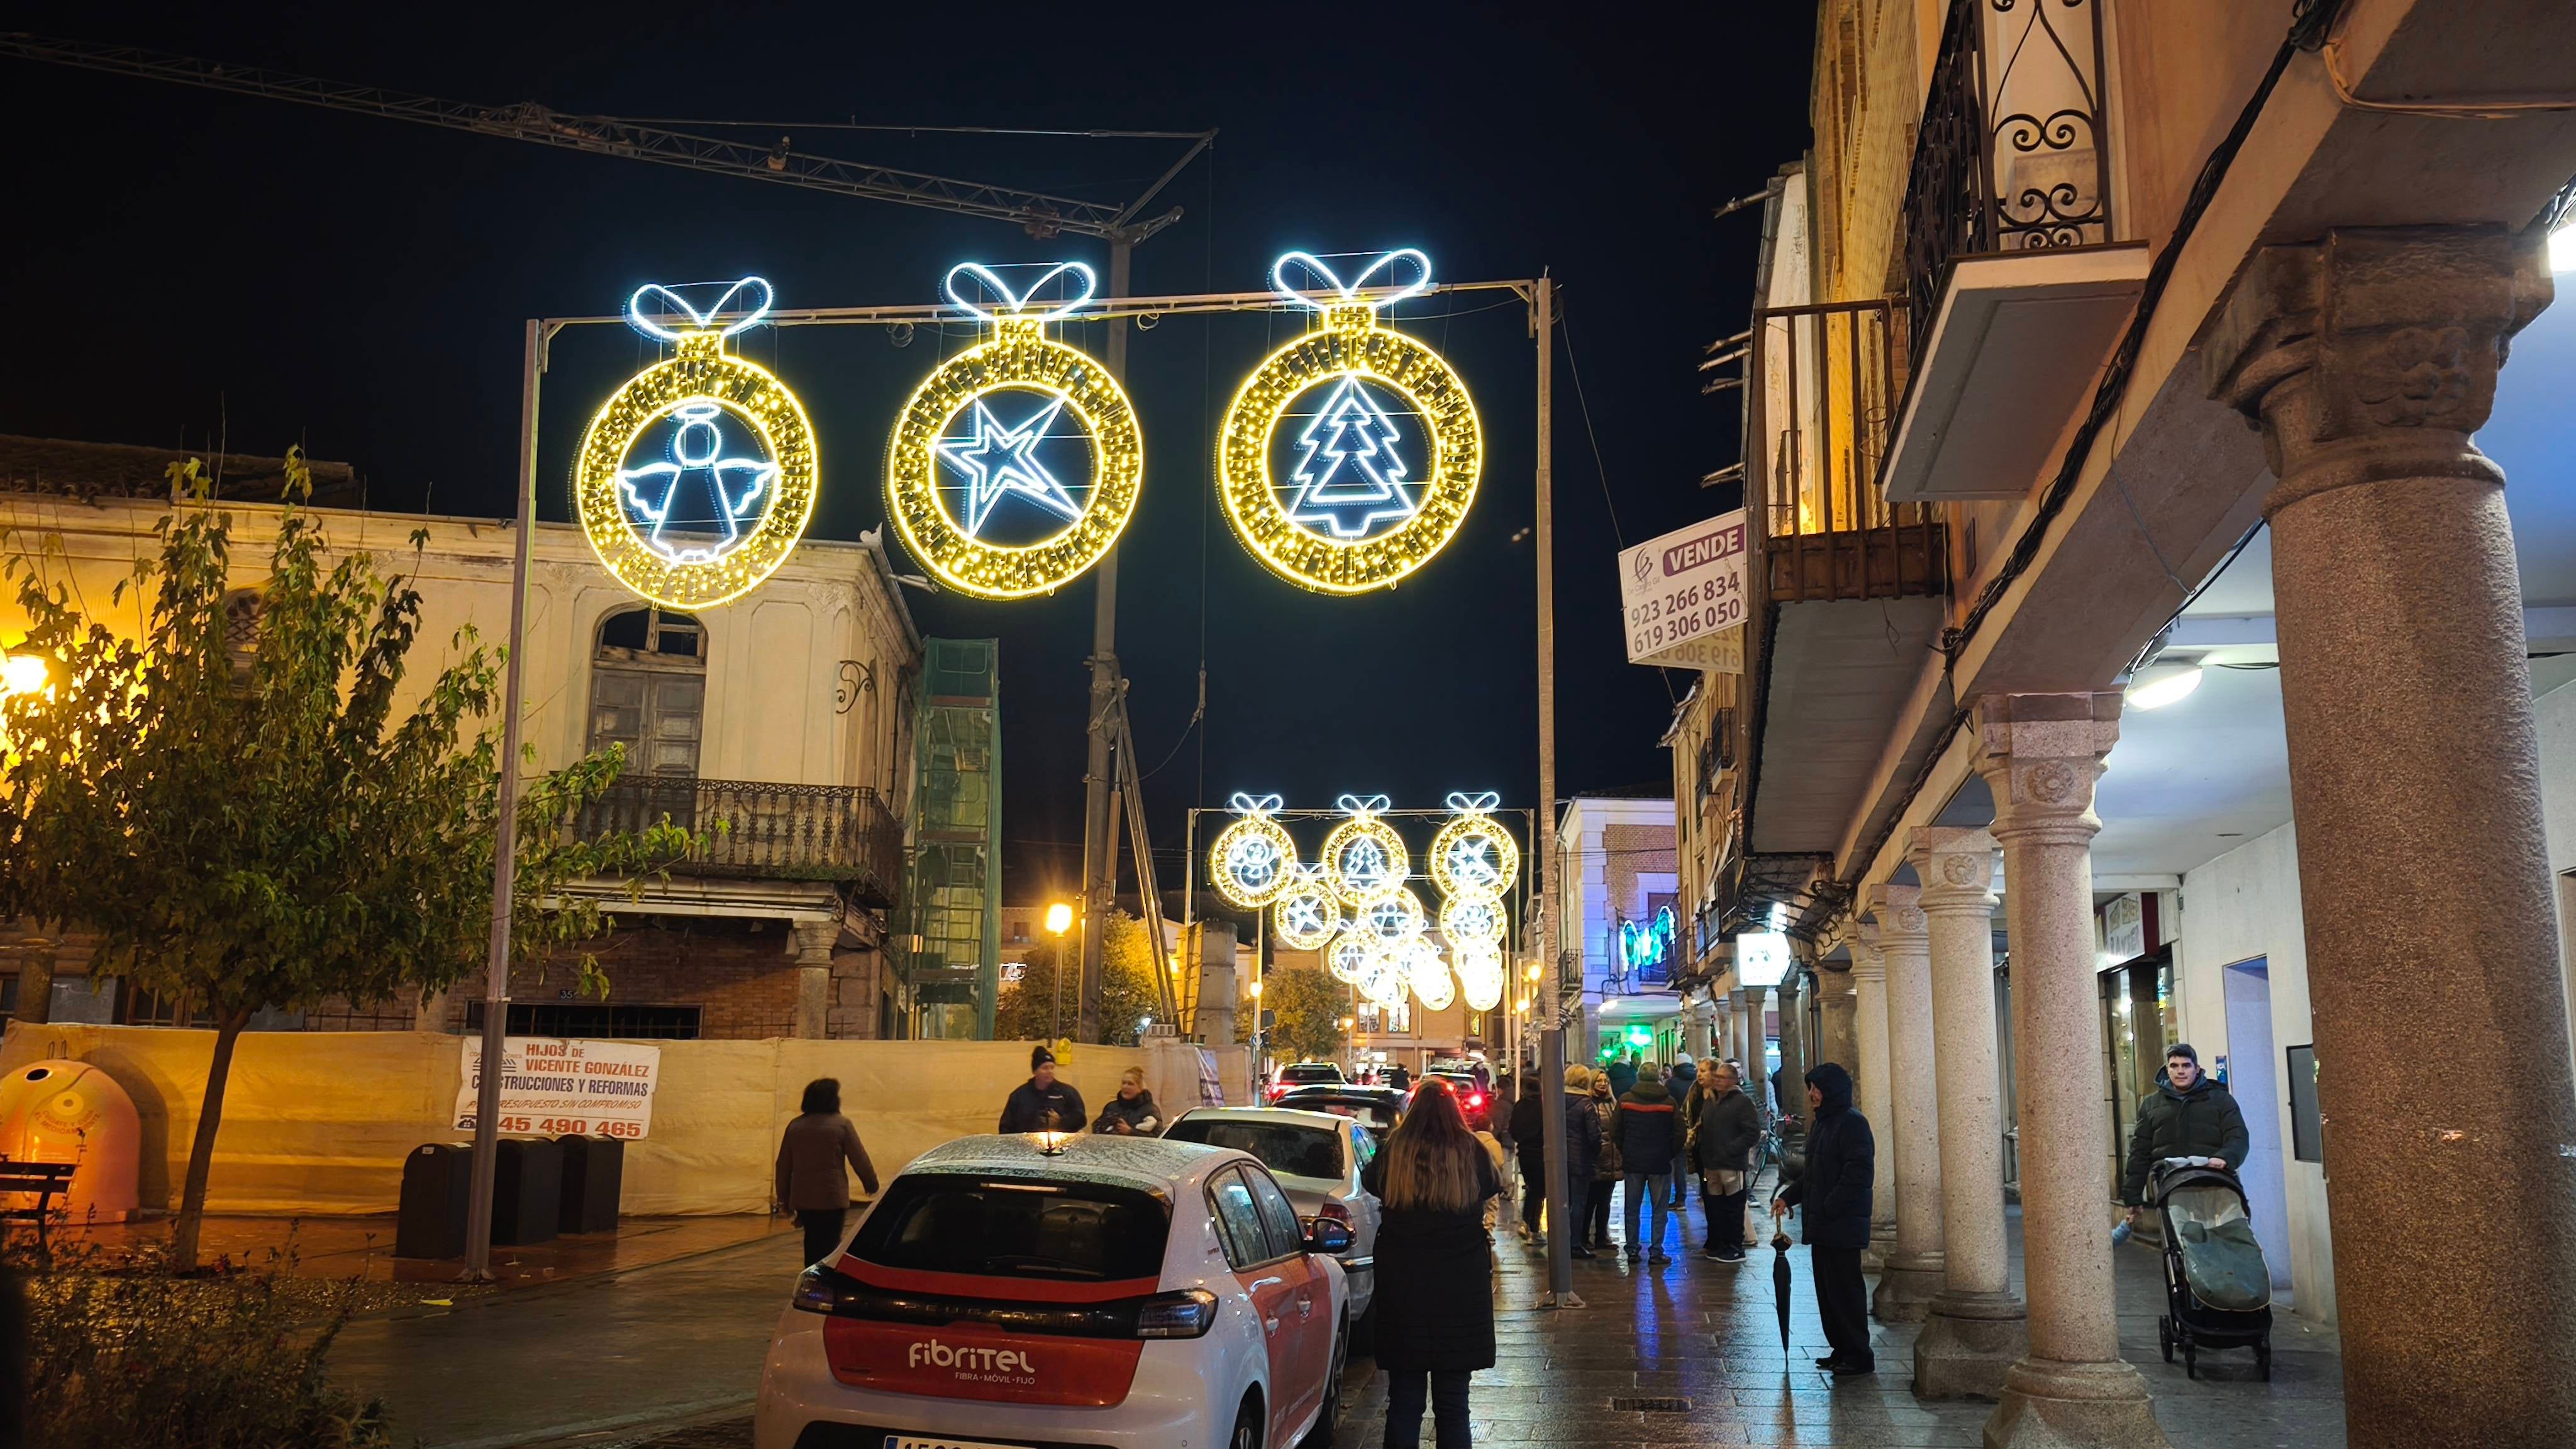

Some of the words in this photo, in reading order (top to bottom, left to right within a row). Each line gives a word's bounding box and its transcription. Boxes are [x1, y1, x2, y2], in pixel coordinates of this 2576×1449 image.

[1669, 529, 1739, 572] VENDE
[1631, 599, 1661, 628] 923
[1665, 585, 1699, 616] 266
[1703, 571, 1740, 601] 834
[1635, 625, 1663, 653] 619
[1667, 611, 1701, 641] 306
[1705, 598, 1740, 628] 050
[526, 1043, 568, 1057] HIJOS
[572, 1048, 584, 1058] DE
[526, 1058, 580, 1074] VICENTE
[584, 1062, 650, 1077] GONZÁLEZ
[472, 1074, 574, 1092] CTRUCCIONES
[579, 1079, 586, 1093] Y
[589, 1079, 648, 1097] REFORMAS
[499, 1099, 559, 1109] RESUPUESTO
[559, 1100, 577, 1109] SIN
[578, 1101, 642, 1109] COMPROMISO
[539, 1118, 587, 1134] 490
[595, 1121, 641, 1137] 465
[955, 1372, 979, 1381] FIBRA
[984, 1374, 1011, 1384] MÓVIL
[1016, 1376, 1035, 1385] FIJO
